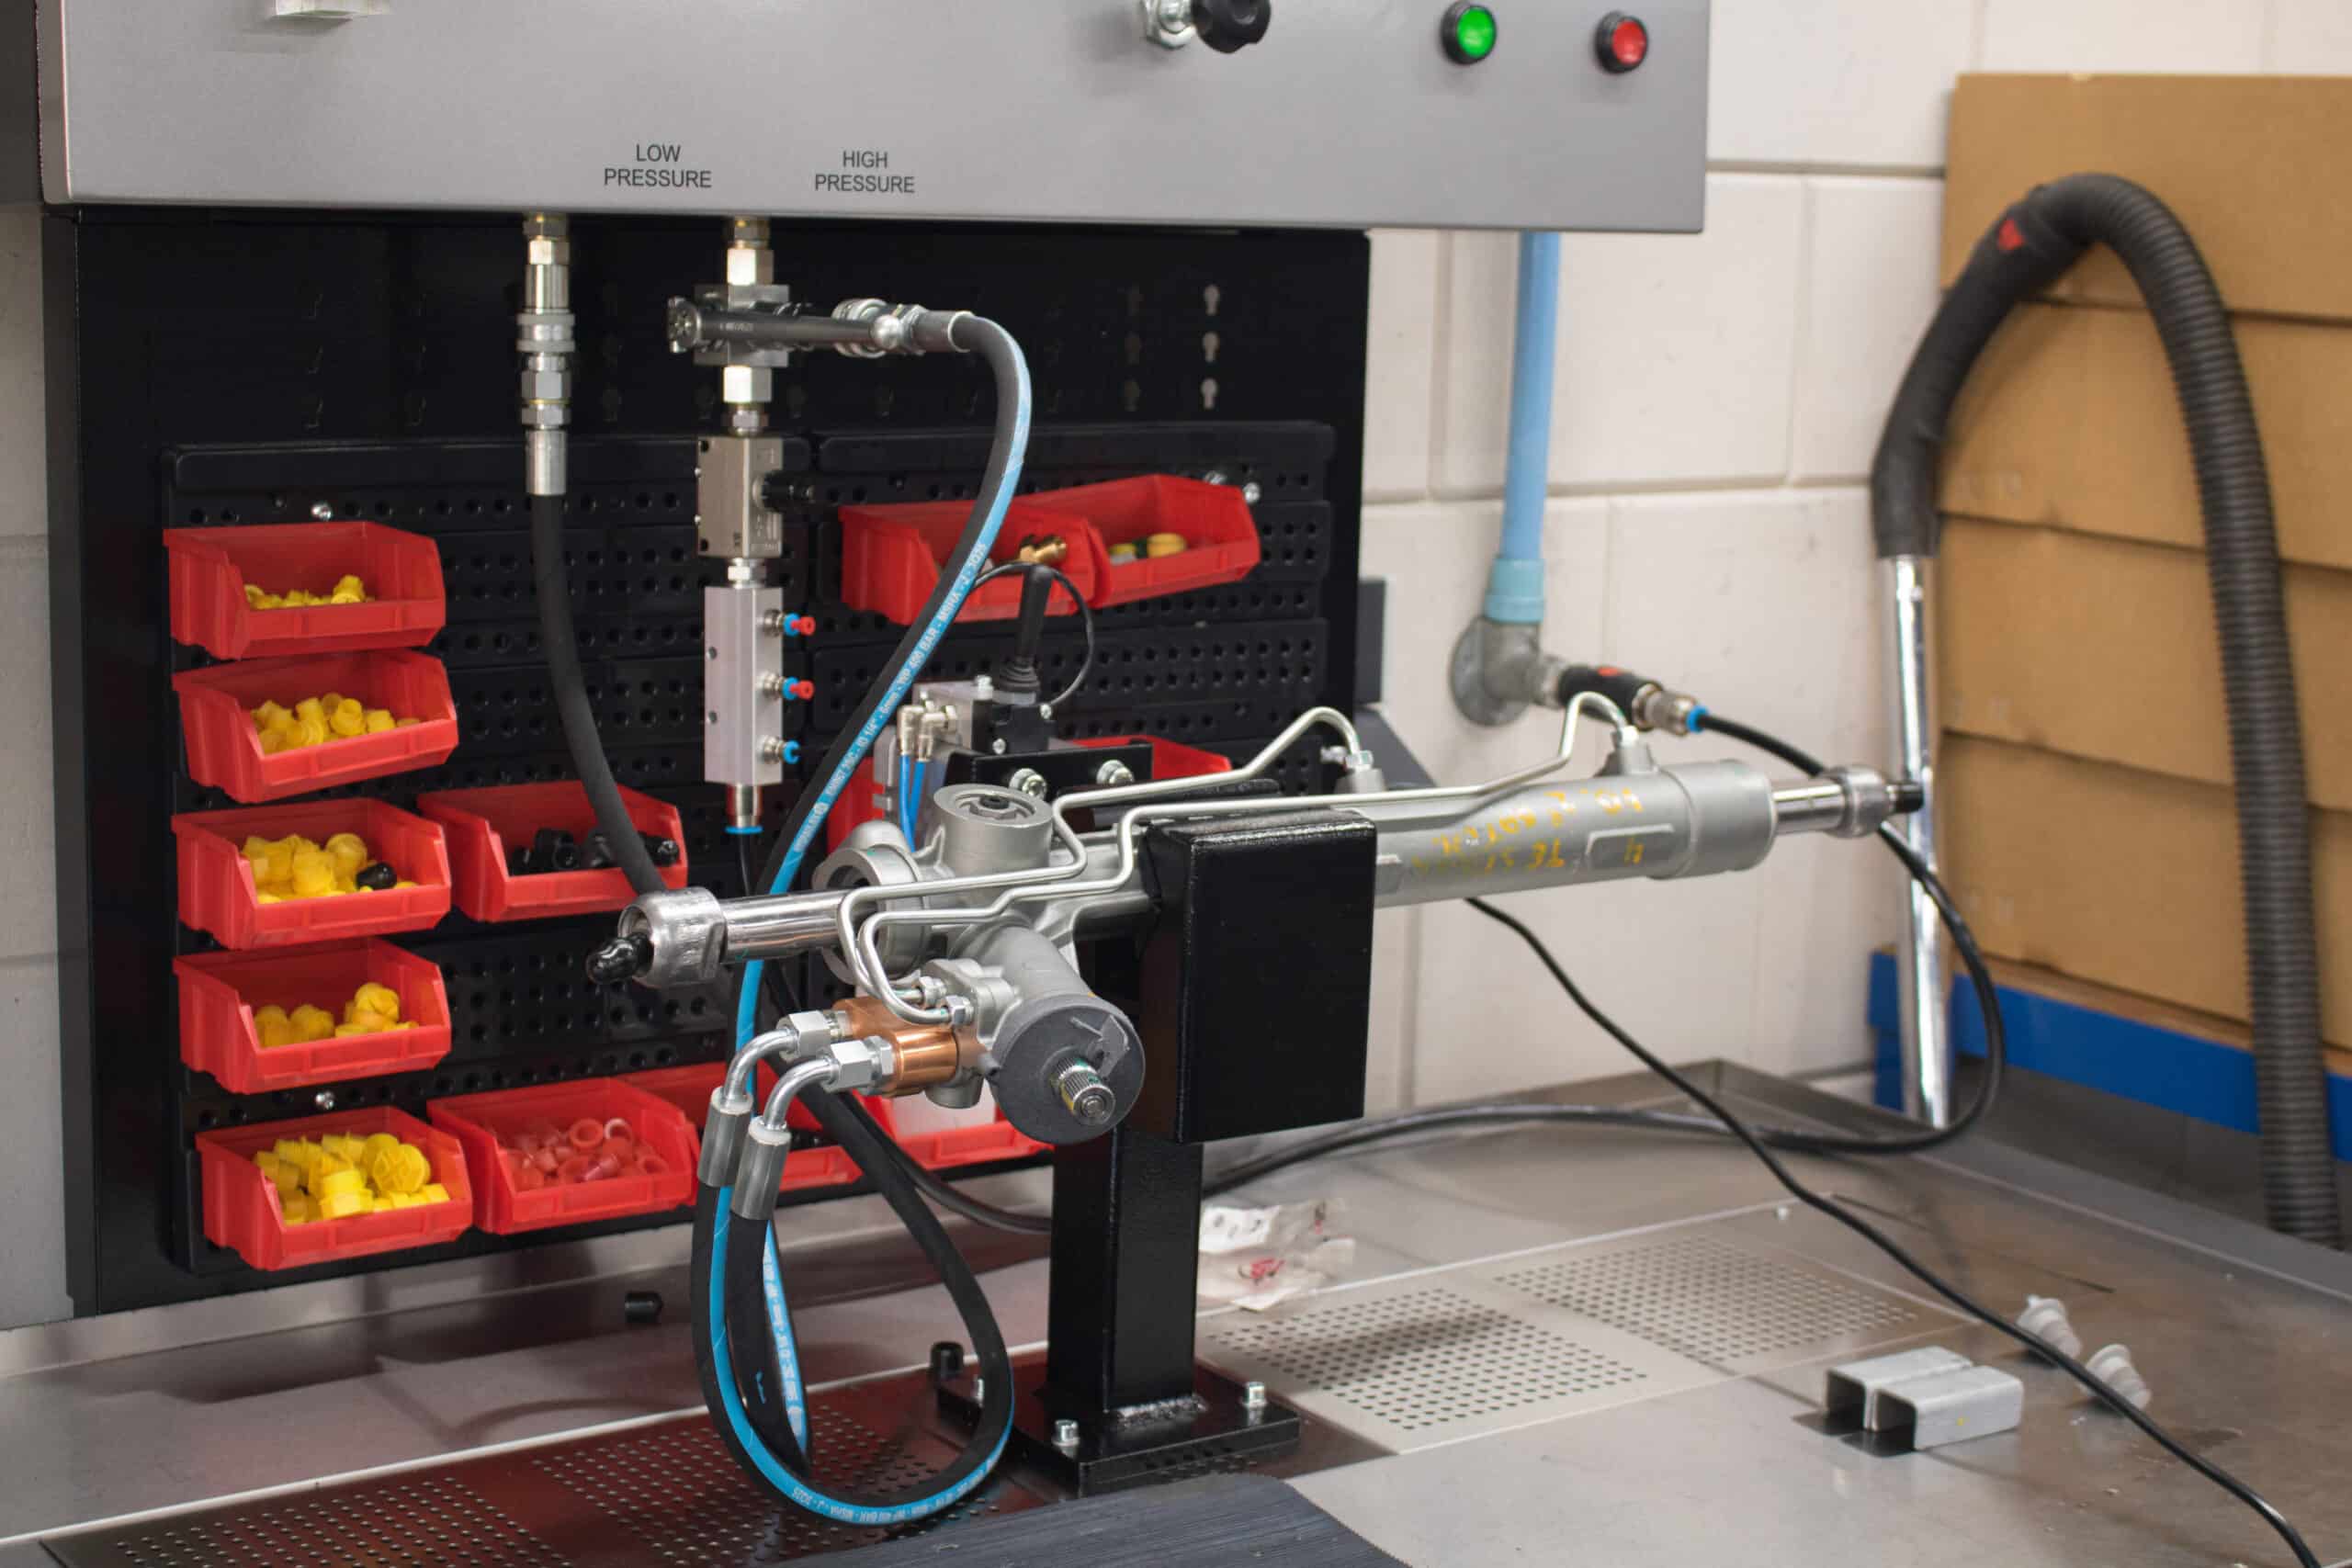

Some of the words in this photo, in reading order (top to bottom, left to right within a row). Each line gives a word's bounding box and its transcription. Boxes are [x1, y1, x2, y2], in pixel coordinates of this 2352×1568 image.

[635, 143, 682, 163] LOW
[842, 151, 889, 169] HIGH
[604, 167, 713, 189] PRESSURE
[814, 174, 916, 194] PRESSURE
[920, 627, 937, 650] BAR
